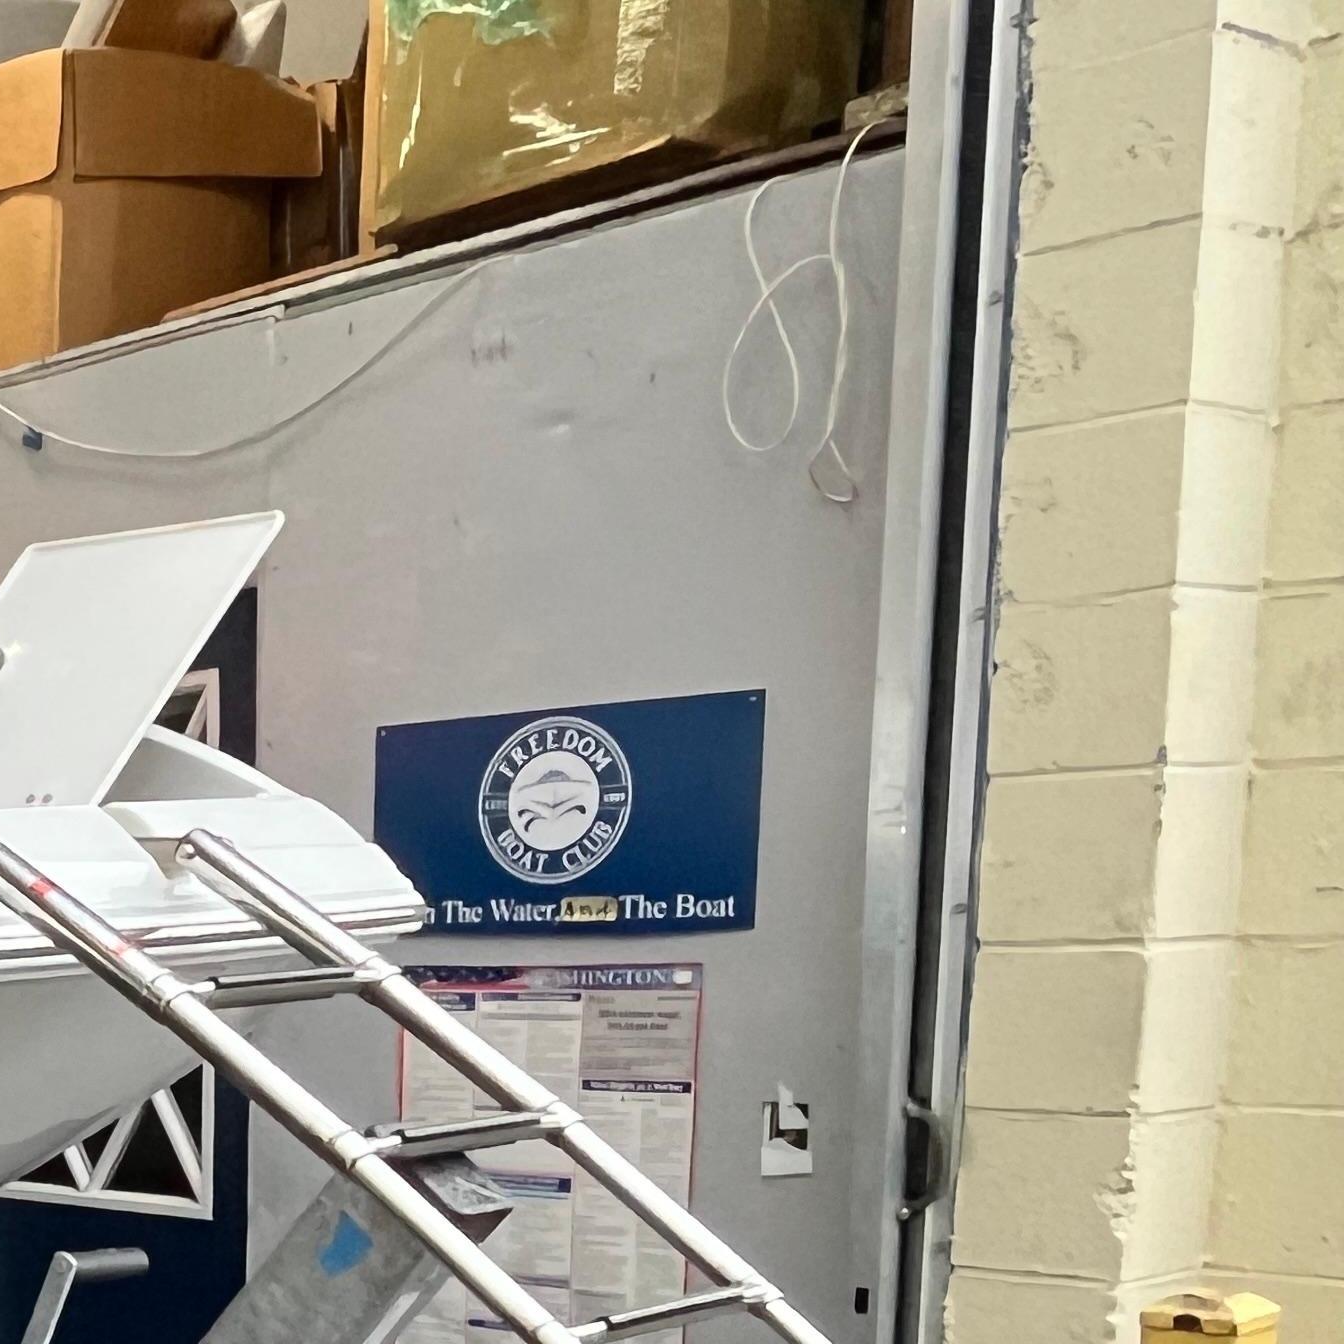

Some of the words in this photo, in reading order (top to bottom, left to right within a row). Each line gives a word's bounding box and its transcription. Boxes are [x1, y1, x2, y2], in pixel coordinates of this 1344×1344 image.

[498, 728, 613, 778] FREEDOM
[497, 829, 549, 872] BOAT
[562, 820, 613, 872] CLUB
[442, 900, 483, 924] The
[618, 894, 668, 919] The
[675, 894, 735, 918] Boat
